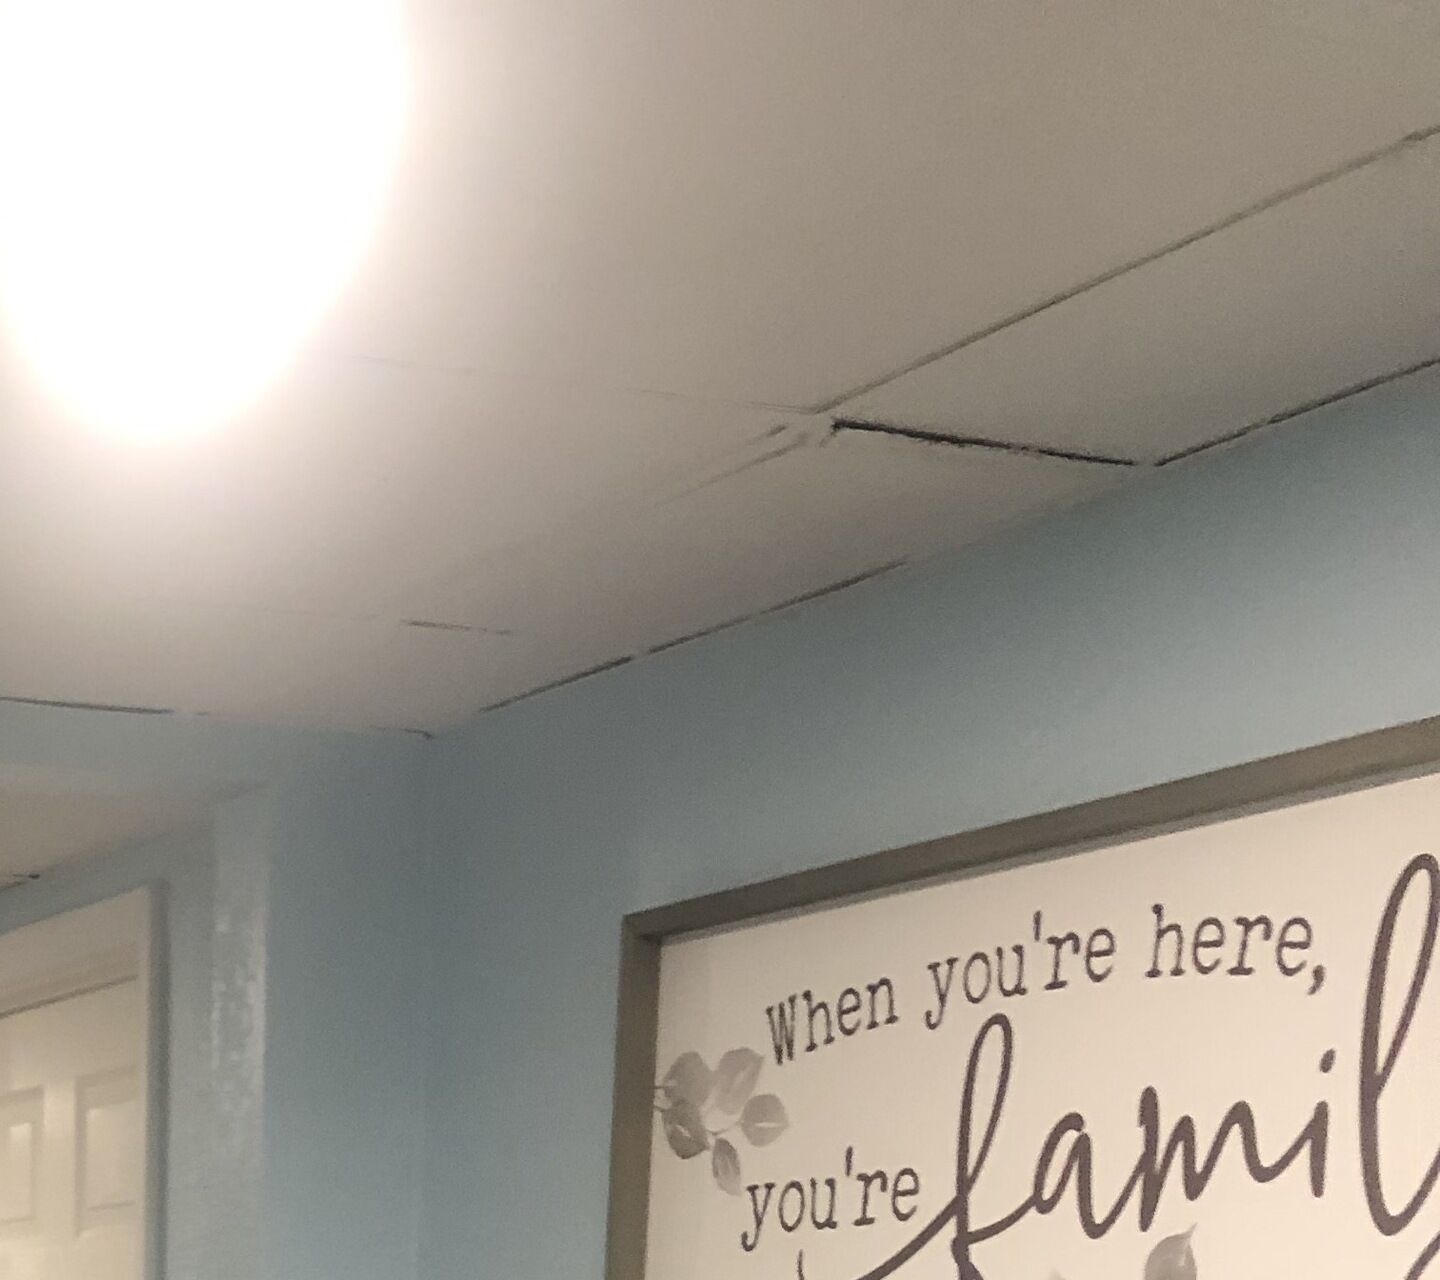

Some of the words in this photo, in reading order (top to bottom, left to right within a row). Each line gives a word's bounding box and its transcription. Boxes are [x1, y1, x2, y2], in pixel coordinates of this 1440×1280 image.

[765, 976, 900, 1065] When
[924, 910, 1118, 1031] you're
[1144, 903, 1329, 996] here,
[740, 1146, 921, 1253] you're
